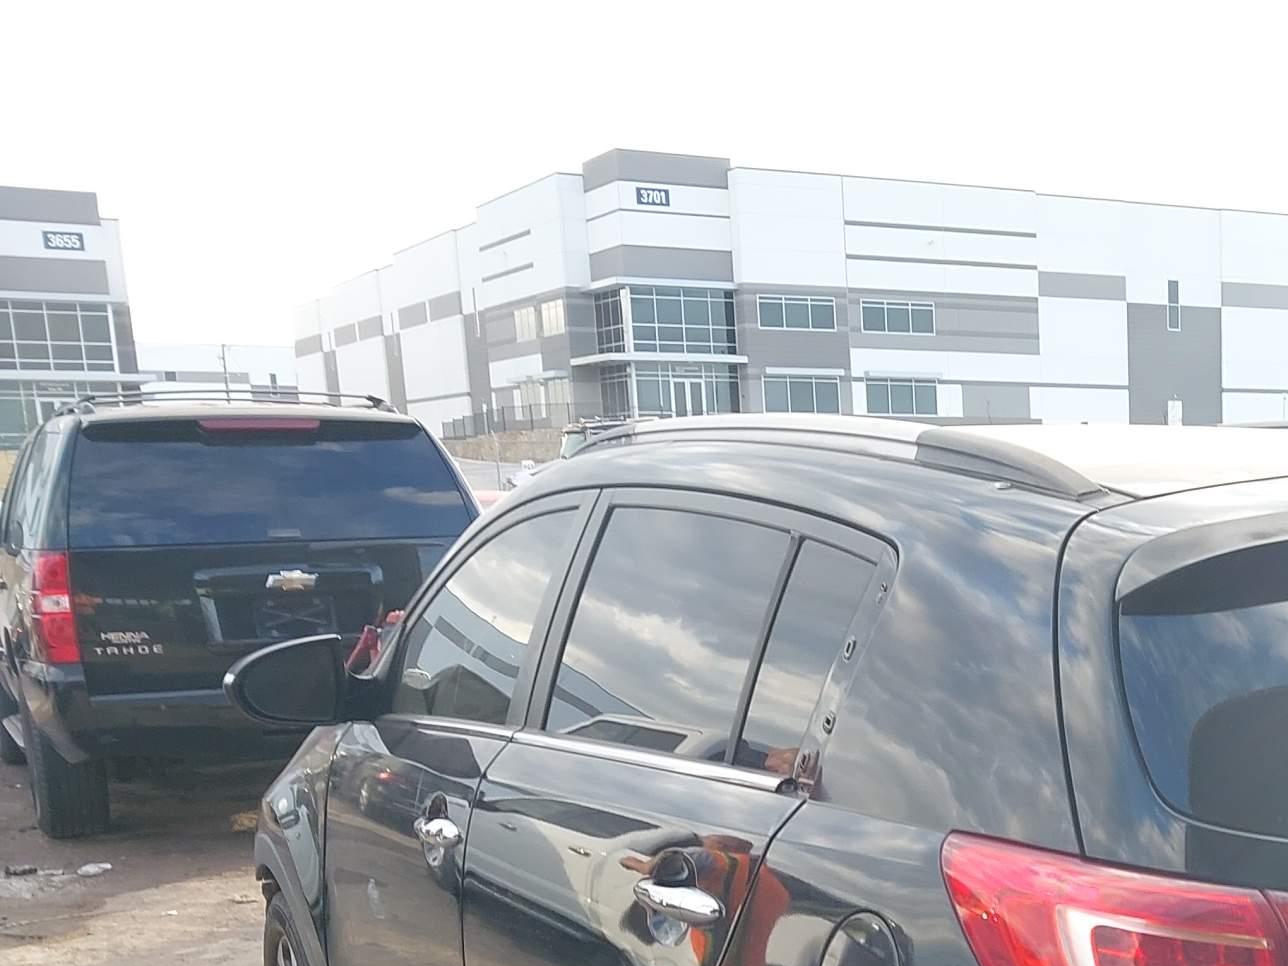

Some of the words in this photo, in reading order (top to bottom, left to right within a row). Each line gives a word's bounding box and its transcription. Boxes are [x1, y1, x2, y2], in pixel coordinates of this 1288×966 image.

[640, 189, 666, 204] 3701
[47, 233, 81, 249] 3655
[94, 643, 164, 655] TAHOE
